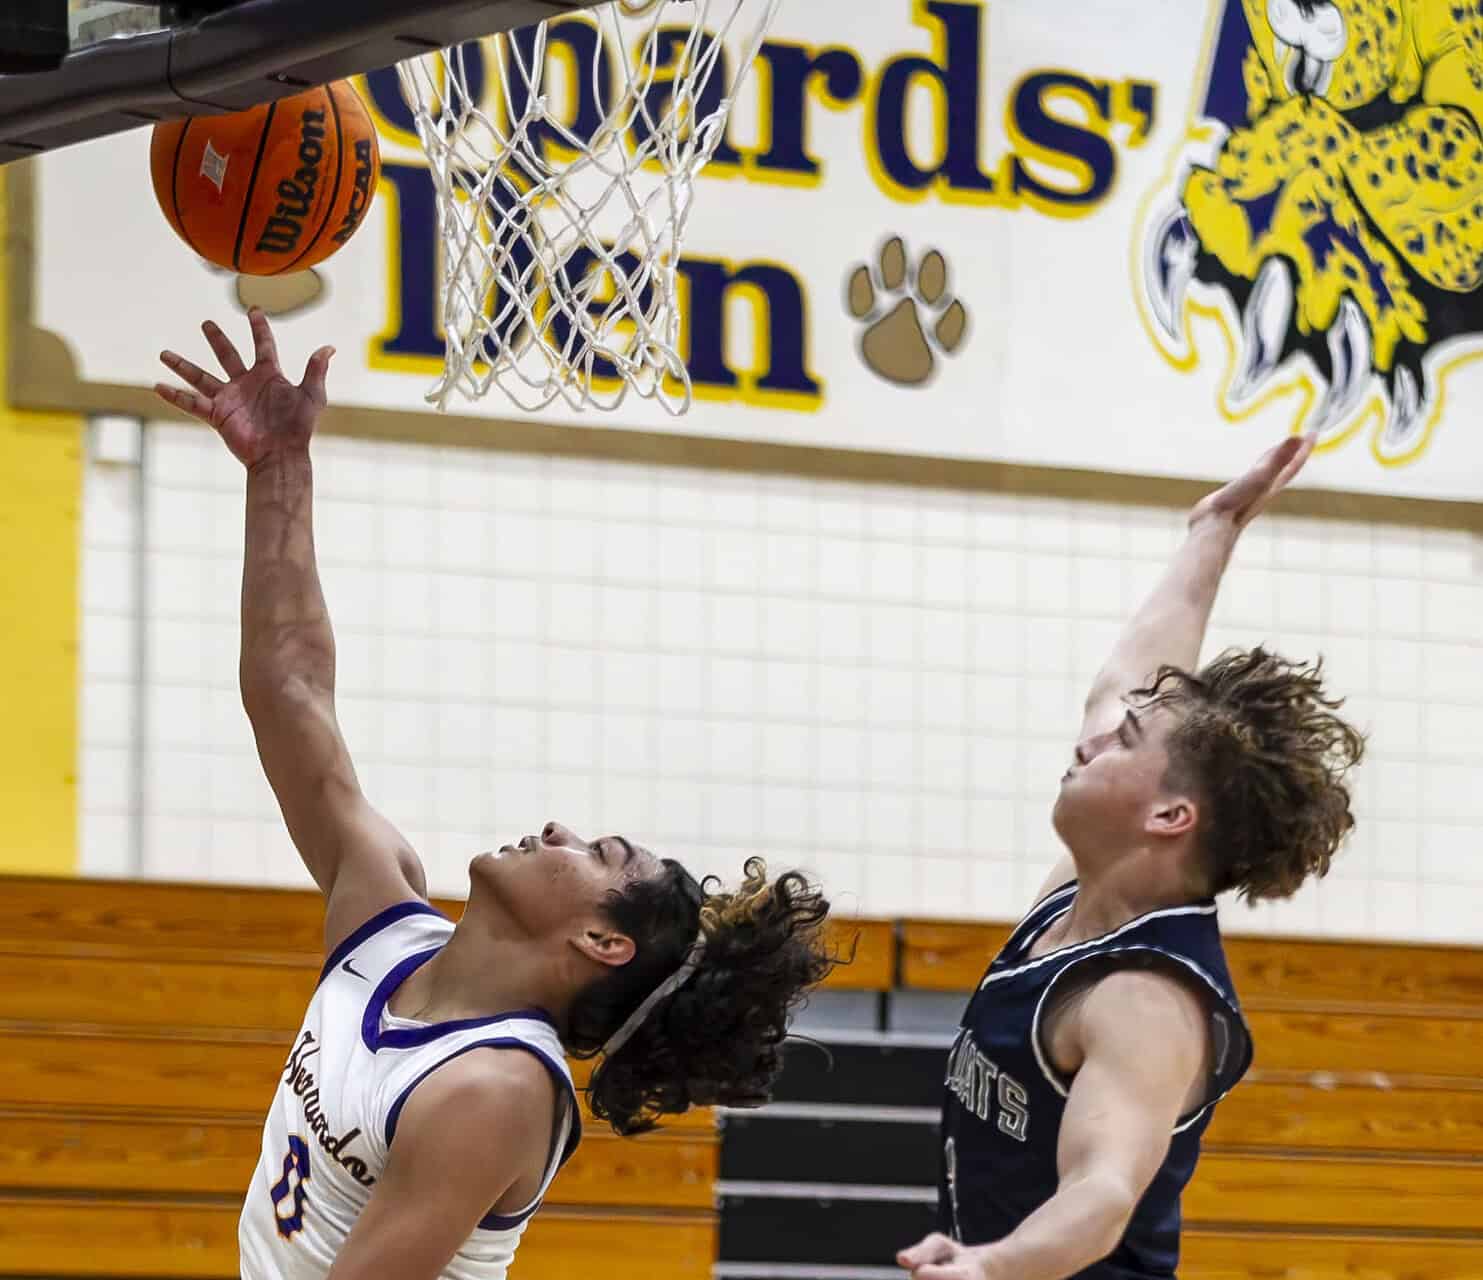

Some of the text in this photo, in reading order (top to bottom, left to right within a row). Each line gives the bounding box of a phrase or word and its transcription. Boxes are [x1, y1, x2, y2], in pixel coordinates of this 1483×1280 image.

[256, 105, 325, 254] Wilson
[352, 0, 1156, 216] opards'
[331, 139, 372, 243] NCAA
